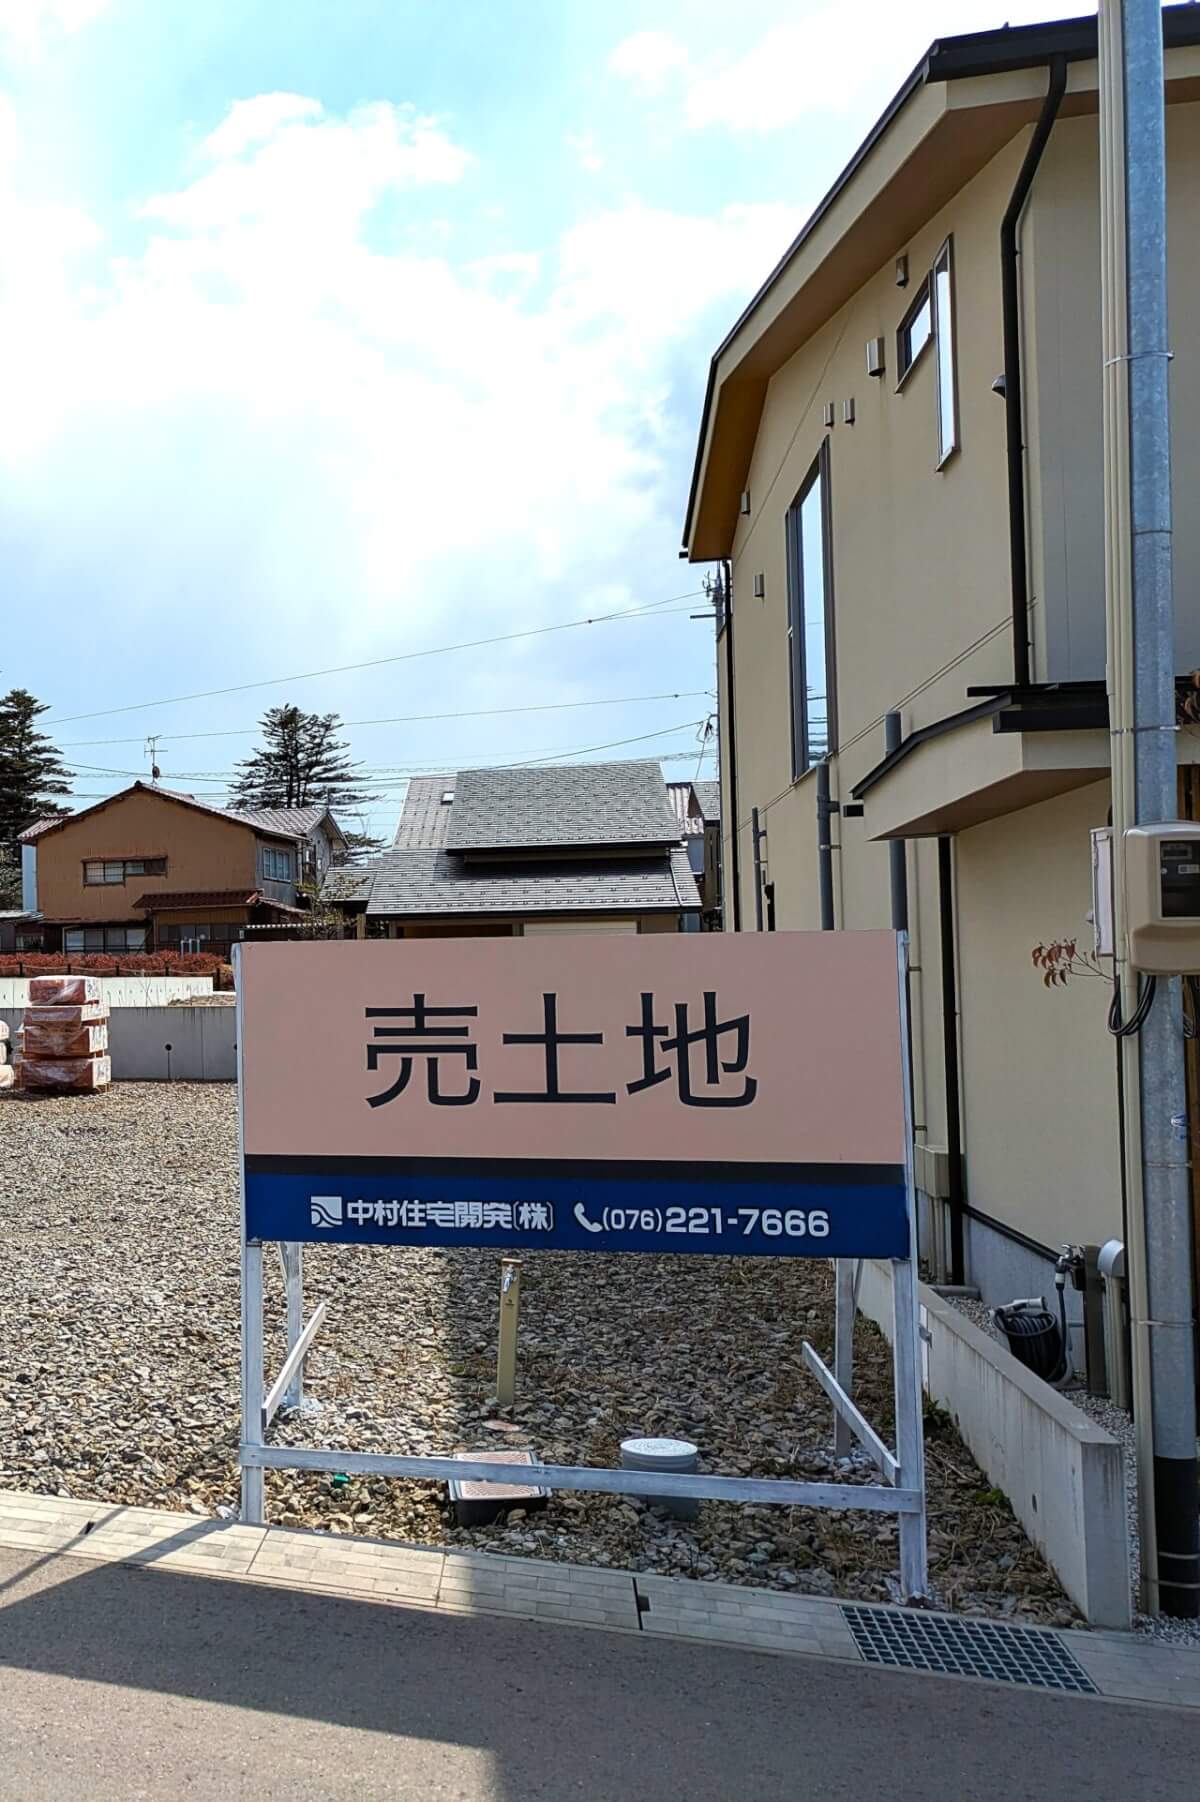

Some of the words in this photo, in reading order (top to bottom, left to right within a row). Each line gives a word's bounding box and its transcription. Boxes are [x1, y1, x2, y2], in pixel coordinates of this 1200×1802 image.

[365, 992, 757, 1108] 売土地
[603, 1206, 830, 1237] (076)221-7666
